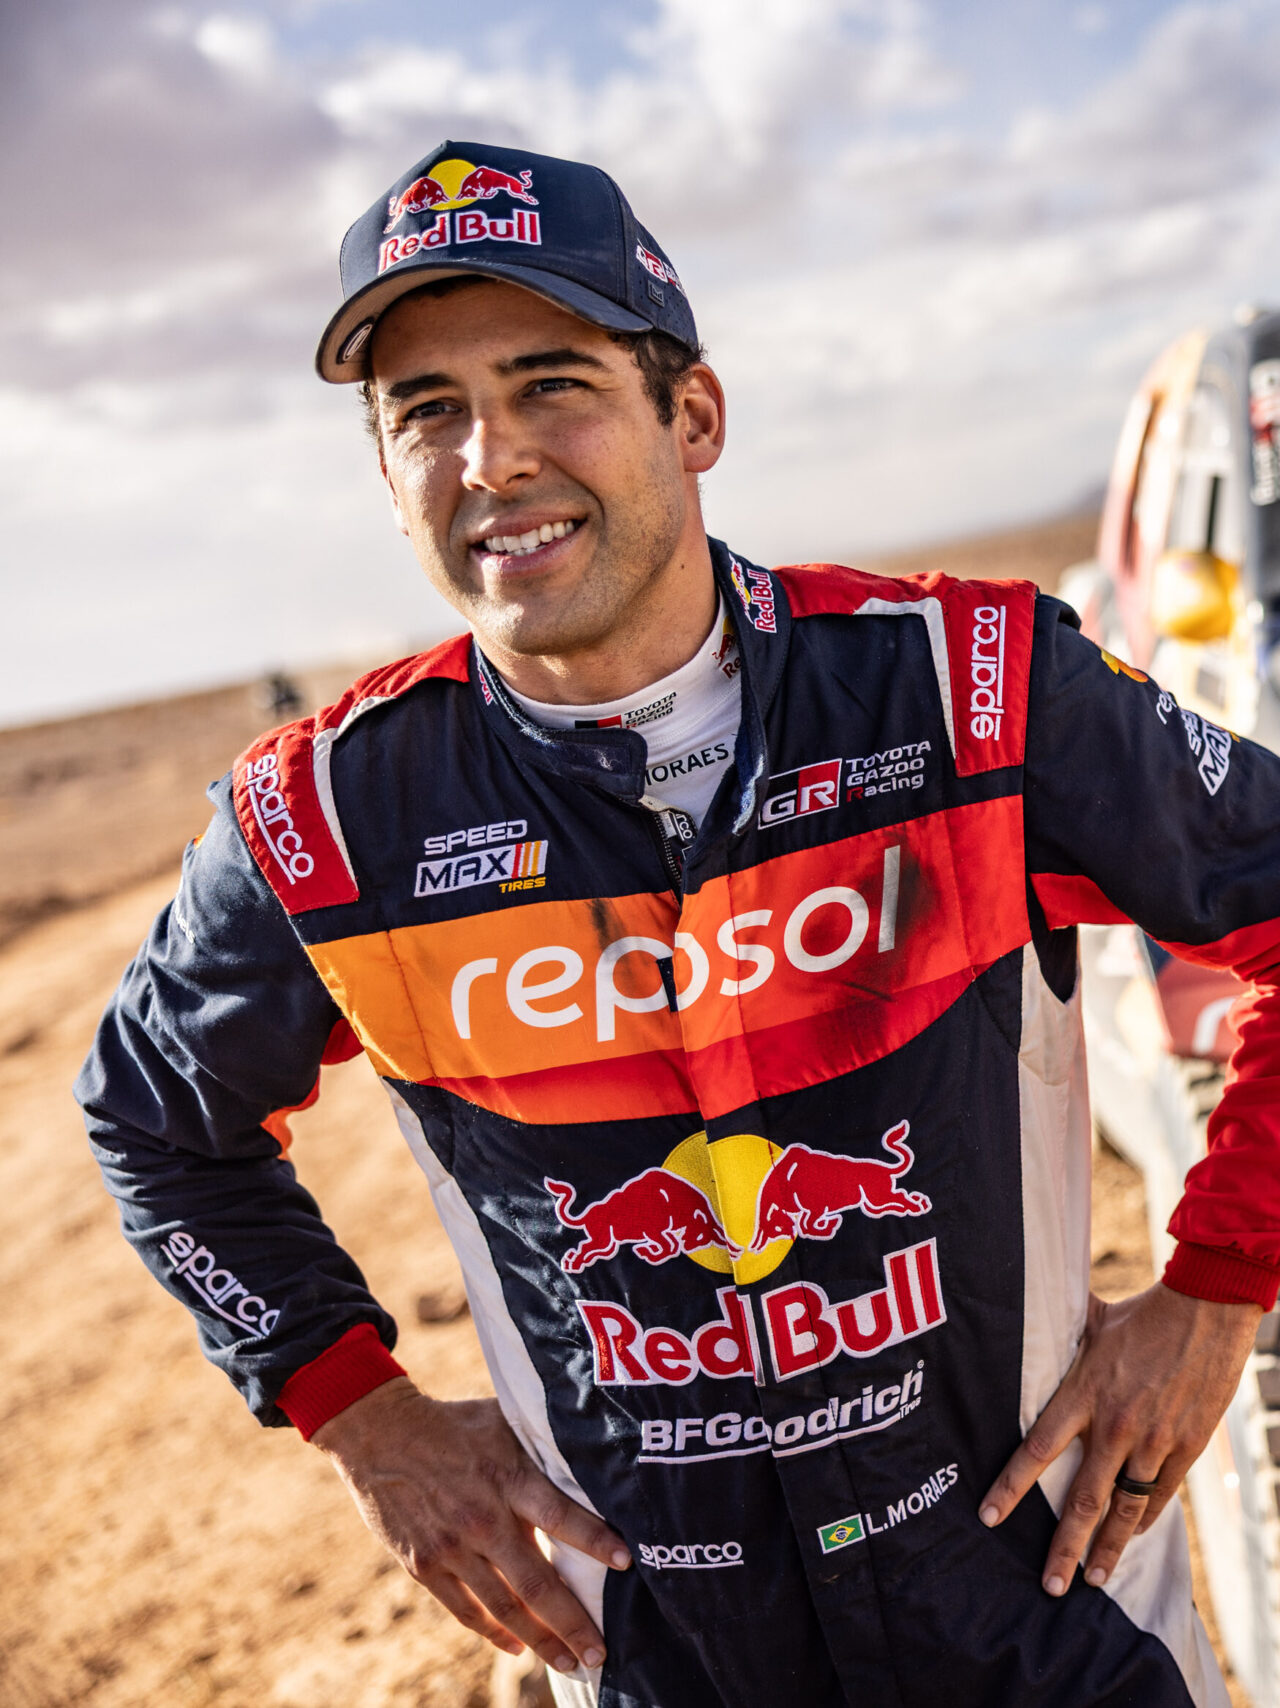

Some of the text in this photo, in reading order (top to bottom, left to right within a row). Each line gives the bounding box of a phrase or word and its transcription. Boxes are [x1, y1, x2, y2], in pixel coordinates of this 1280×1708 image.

[378, 209, 542, 276] Red Bull
[747, 569, 777, 633] Red Bull
[971, 606, 1005, 740] sparco
[624, 691, 677, 719] TOYOTA
[625, 701, 674, 725] GAZOO
[626, 706, 673, 729] Racing
[846, 740, 932, 773] TOYOTA
[846, 757, 925, 787] GAZOO
[762, 780, 836, 823] GR
[846, 773, 924, 803] Racing
[246, 754, 315, 878] sparco
[424, 819, 528, 855] SPEED
[419, 850, 512, 893] MAX
[499, 876, 547, 894] TIRES
[450, 845, 901, 1042] repsol
[577, 1238, 946, 1386] Red Bull
[641, 1369, 923, 1451] BFGoodrich
[866, 1463, 958, 1536] L.MORAES
[638, 1541, 743, 1570] sparco
